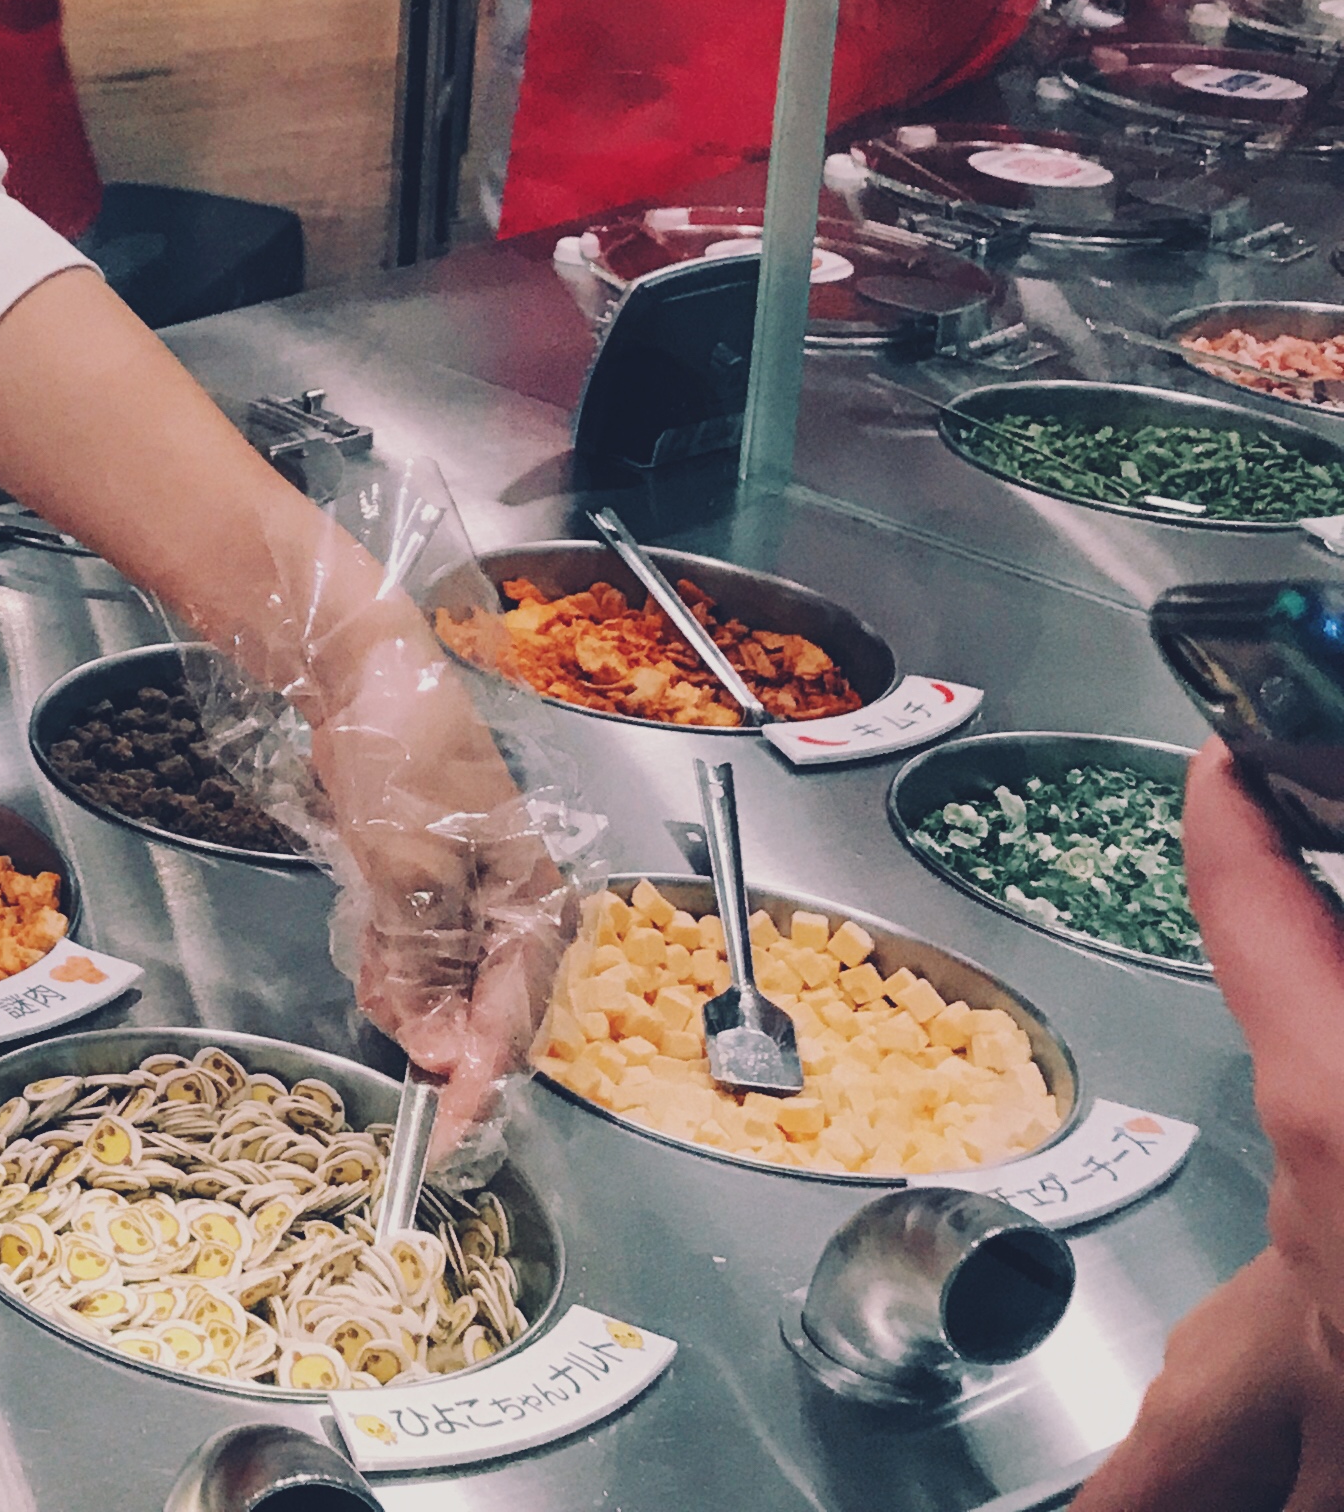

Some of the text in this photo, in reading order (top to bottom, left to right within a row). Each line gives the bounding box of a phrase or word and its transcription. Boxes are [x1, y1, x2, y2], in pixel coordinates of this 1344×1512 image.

[851, 701, 932, 738] キムチ
[389, 1338, 624, 1438] ひよこちゃんナルト
